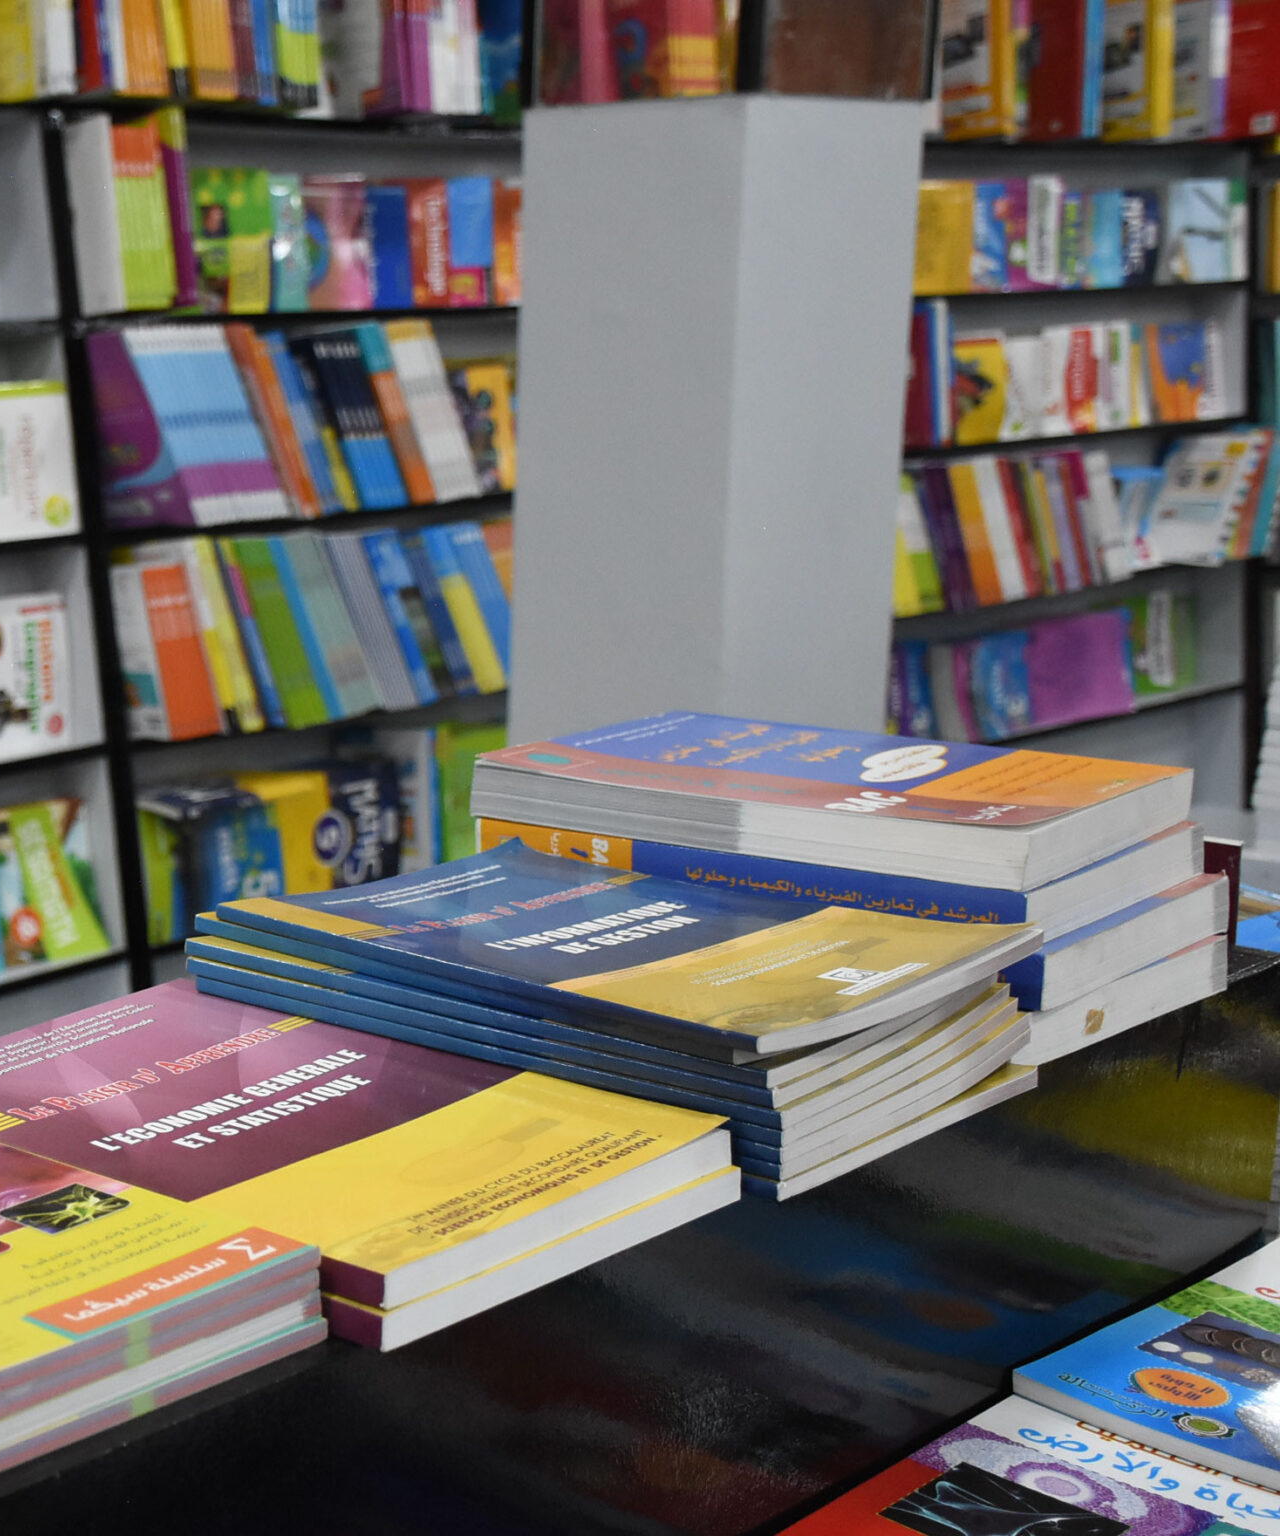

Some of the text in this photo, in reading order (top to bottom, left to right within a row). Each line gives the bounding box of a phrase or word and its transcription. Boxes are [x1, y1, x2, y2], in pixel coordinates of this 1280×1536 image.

[824, 791, 908, 813] BAC
[484, 899, 688, 951] L'INFORMATIQUE
[551, 913, 699, 955] DE GESTION
[8, 1105, 60, 1122] LE
[41, 1076, 144, 1113] PLAISIR
[156, 1027, 282, 1076] APPRENDRE
[90, 1048, 368, 1152] L'ECONOMIE GENERALE
[172, 1073, 373, 1151] ET STATISTIQUE
[590, 1158, 611, 1170] DE
[606, 1136, 657, 1162] GESTION
[1017, 1427, 1181, 1492] والأرض
